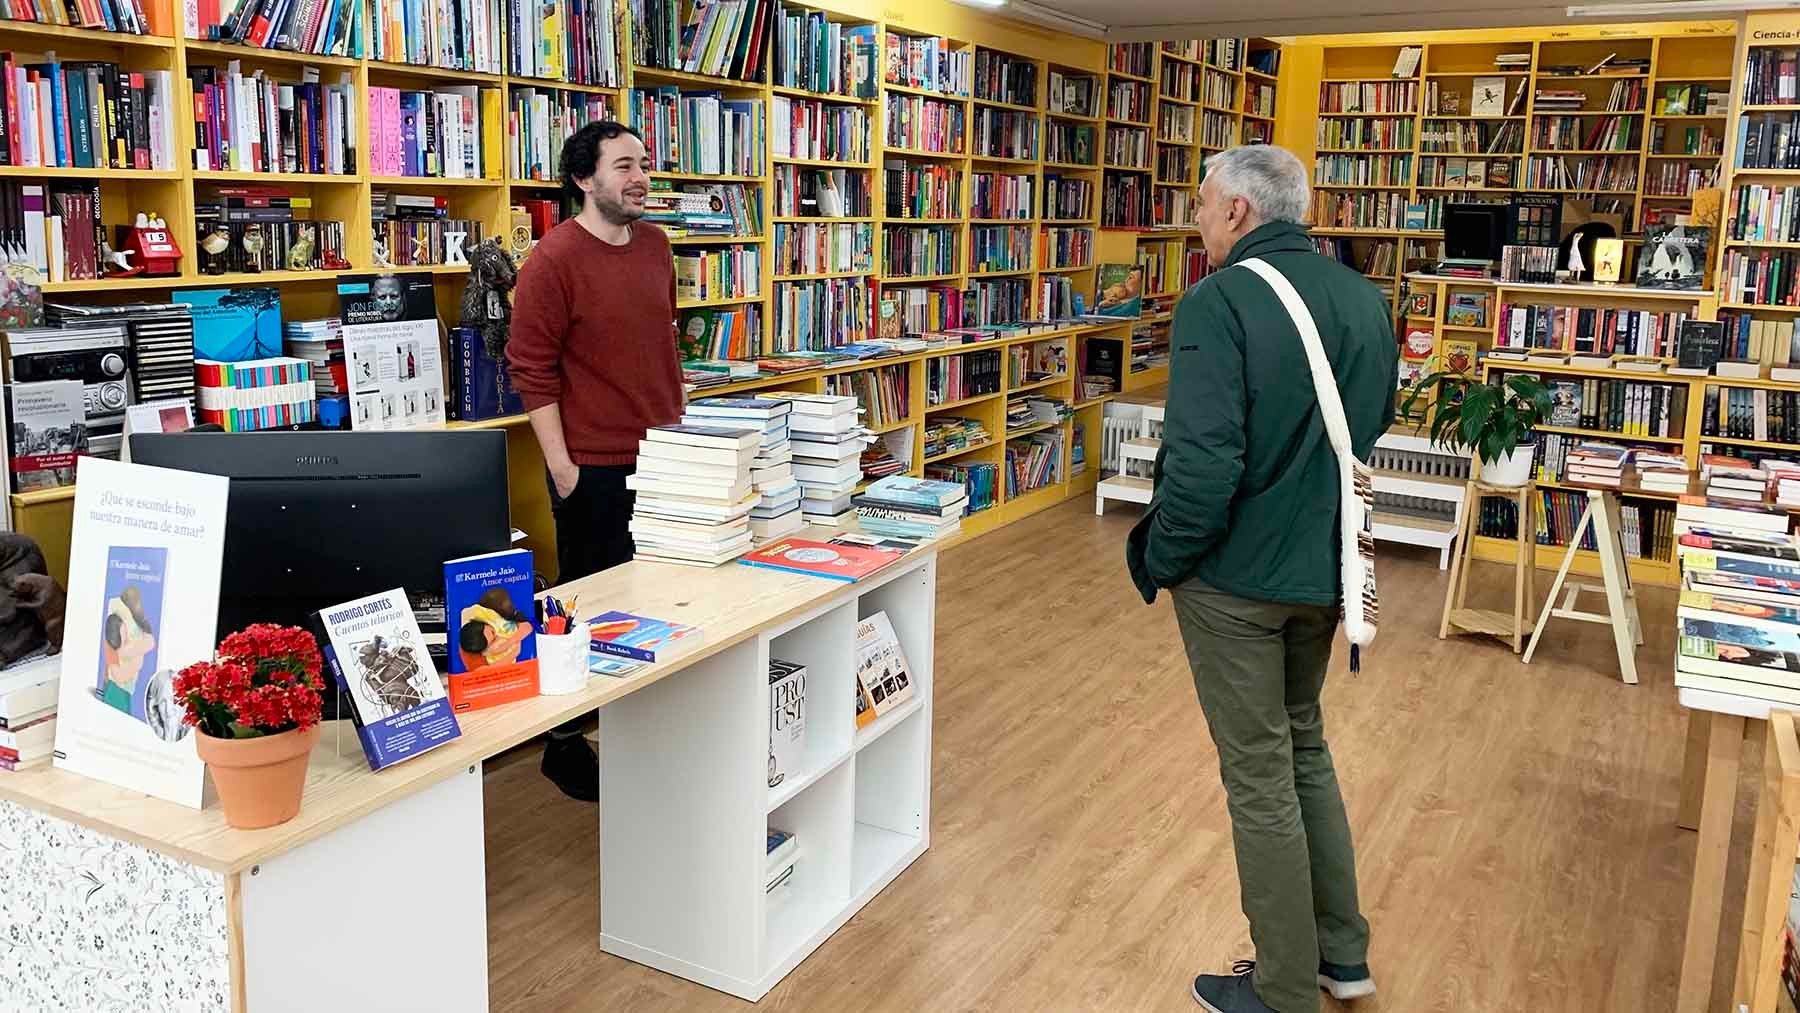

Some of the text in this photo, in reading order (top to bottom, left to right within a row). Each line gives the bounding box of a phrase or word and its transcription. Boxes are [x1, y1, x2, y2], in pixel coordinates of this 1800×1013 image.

[92, 104, 100, 128] CHINA
[93, 186, 101, 220] GEOLOGÍA
[444, 232, 468, 265] K
[347, 302, 367, 312] JON
[463, 341, 471, 412] GOMBRICH
[125, 498, 135, 507] se
[136, 499, 173, 513] esconde
[175, 501, 197, 519] bajo
[90, 510, 205, 539] nuestra manera de amar?
[464, 566, 515, 581] Karmele Jaio
[481, 571, 529, 587] Amor capital
[328, 598, 393, 625] RODRIGO CORTÉS
[334, 621, 370, 637] Cuentos
[776, 674, 806, 708] PRO
[775, 696, 805, 731] UST
